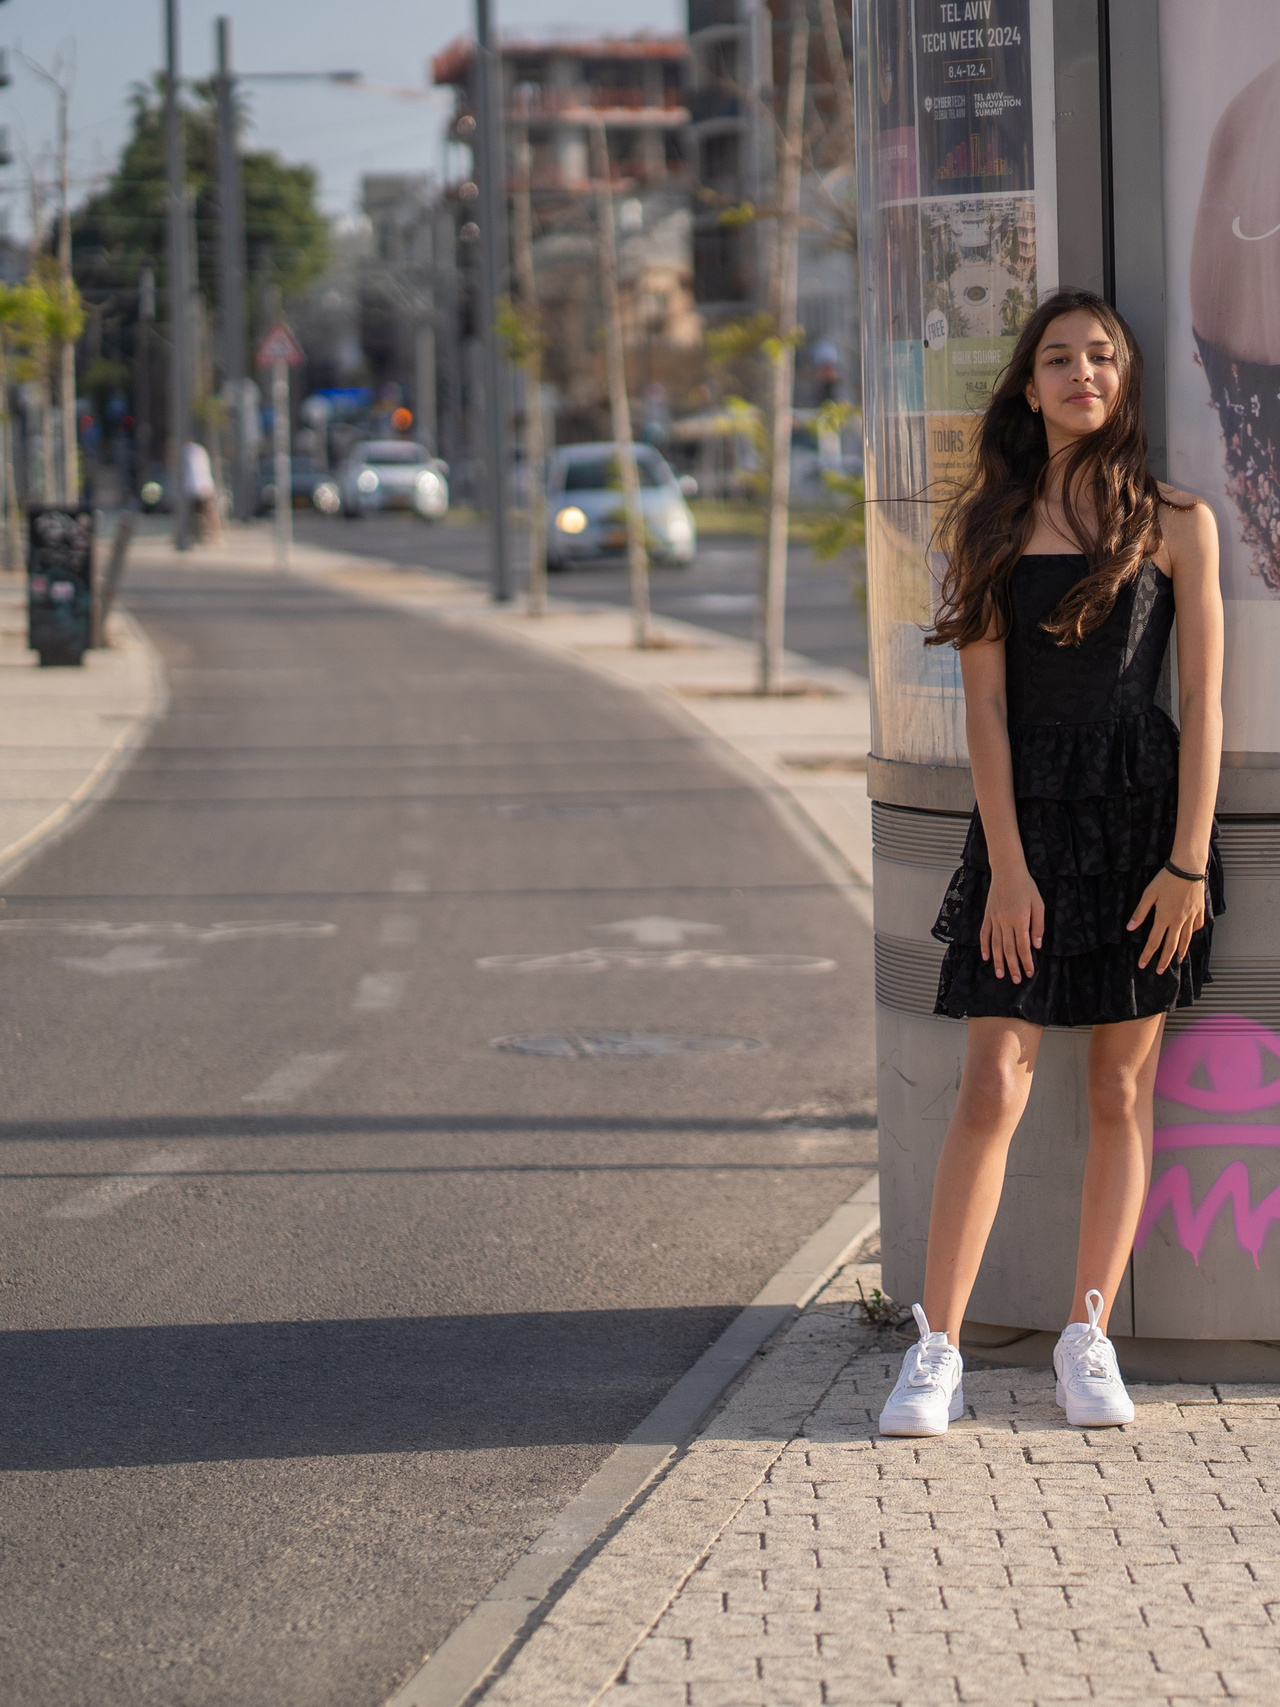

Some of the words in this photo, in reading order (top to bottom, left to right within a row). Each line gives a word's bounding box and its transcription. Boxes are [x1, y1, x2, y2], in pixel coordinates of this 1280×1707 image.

[940, 4, 961, 24] TEL
[964, 0, 992, 21] AVIV
[922, 33, 947, 53] TECH
[949, 29, 984, 51] WEEK
[987, 26, 1021, 47] 2024
[948, 64, 986, 78] 8.4-12.4
[934, 95, 966, 108] CYBERTECH
[973, 93, 985, 101] TEL
[986, 92, 1004, 101] AVIV
[975, 99, 1021, 108] INNOVATION
[975, 108, 1003, 117] SUMMIT
[928, 320, 945, 341] FREE
[973, 350, 1001, 364] SQUARE
[933, 430, 963, 452] TOURS
